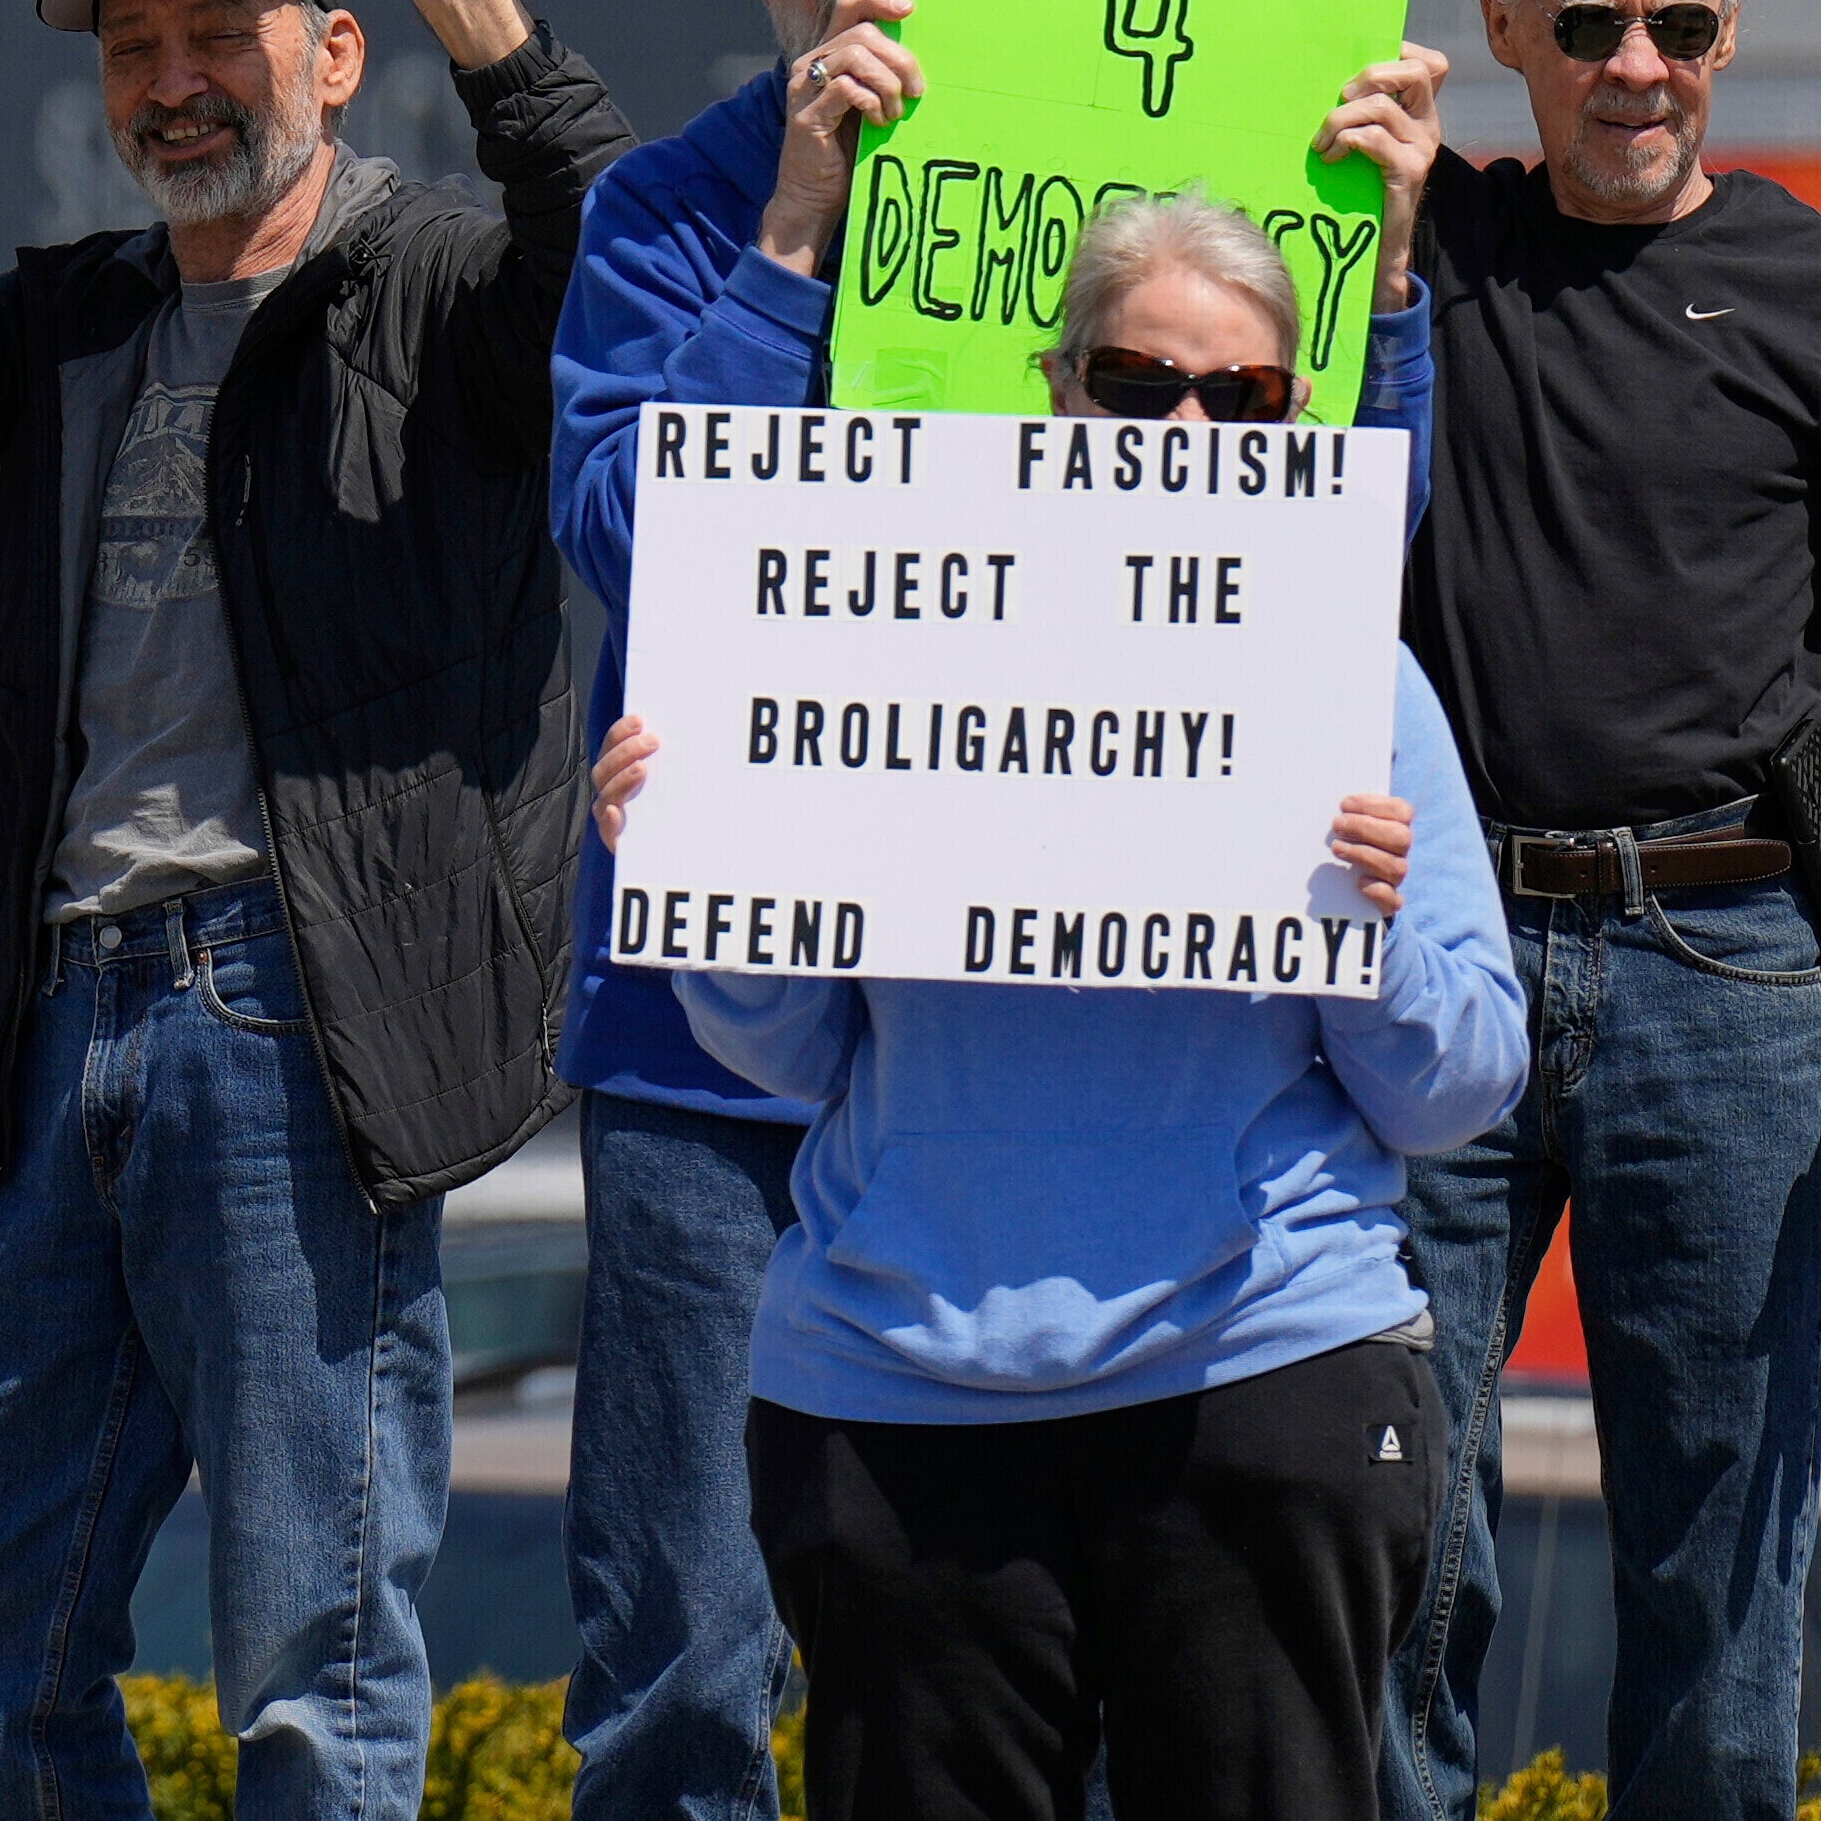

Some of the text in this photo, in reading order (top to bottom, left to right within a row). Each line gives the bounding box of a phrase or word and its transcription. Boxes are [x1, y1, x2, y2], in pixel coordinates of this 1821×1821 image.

[860, 154, 1377, 372] DEMOY
[655, 411, 1346, 498] REJECT FASCISM!
[756, 547, 1243, 625] REJECT THE
[749, 696, 1236, 778] BROLIGARCHY!
[618, 888, 1378, 987] DEFEND DEMOCRACY!
